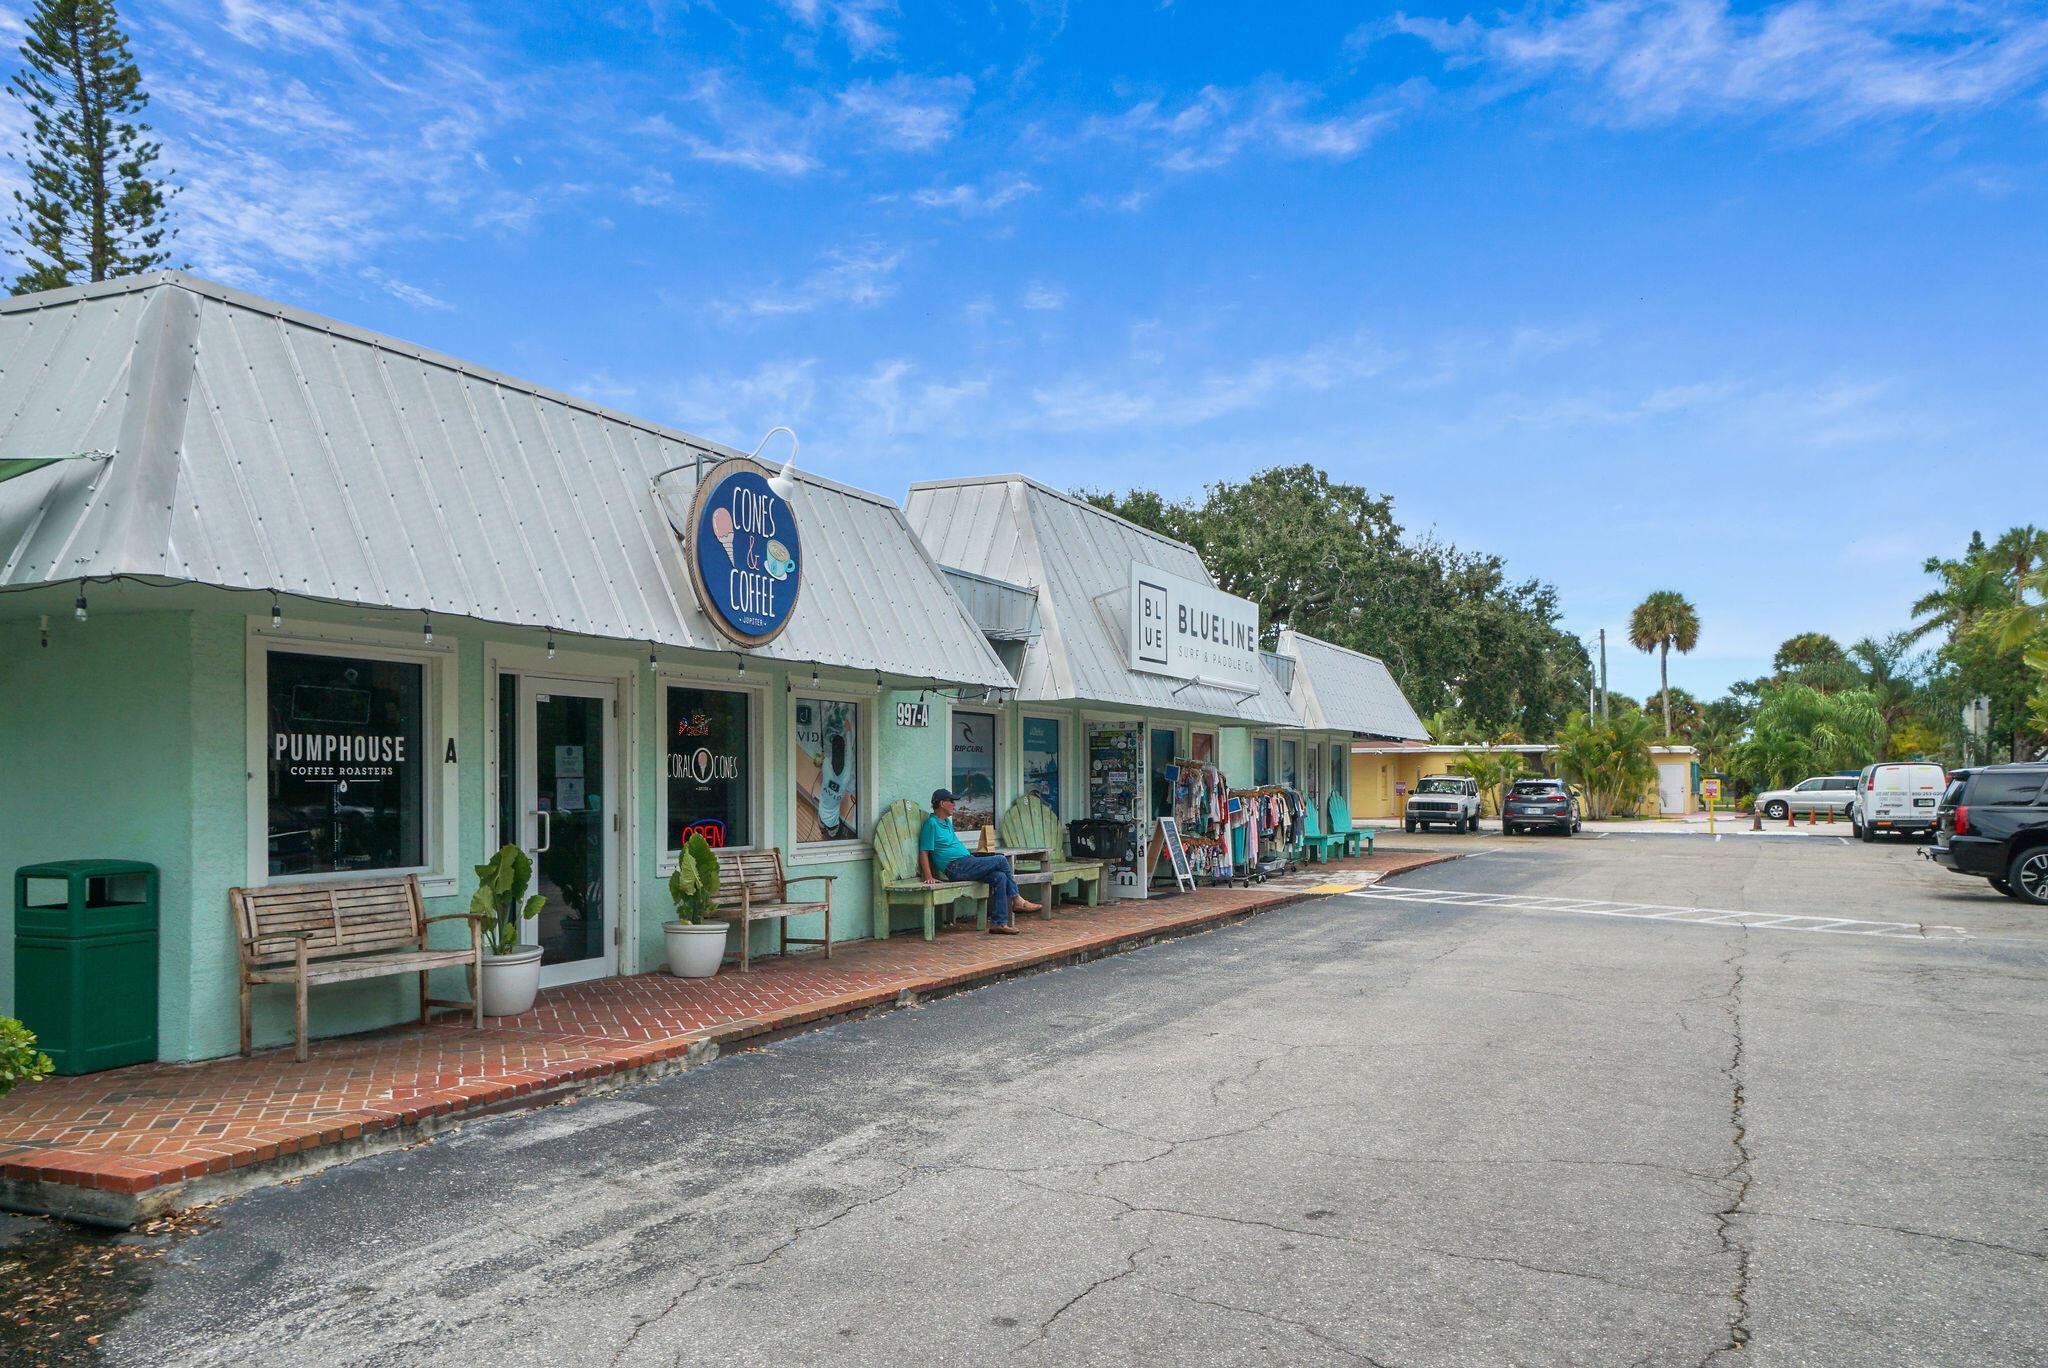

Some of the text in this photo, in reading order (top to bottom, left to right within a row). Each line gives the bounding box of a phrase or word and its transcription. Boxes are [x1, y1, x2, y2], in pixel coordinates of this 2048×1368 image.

[732, 486, 776, 538] CONES
[746, 535, 760, 571] &
[730, 568, 776, 618] COFFEE
[1178, 604, 1254, 652] BLUELINE
[1178, 645, 1199, 660] SURF
[1203, 651, 1208, 663] &
[1212, 653, 1241, 671] PADDLE
[897, 702, 929, 727] 997-A
[275, 733, 405, 762] PUMPHOUSE
[797, 731, 820, 743] VID
[954, 744, 984, 753] RIP CURL
[444, 737, 457, 764] A
[290, 766, 393, 776] COFFEE ROASTERS
[667, 753, 739, 779] CORAL CONES
